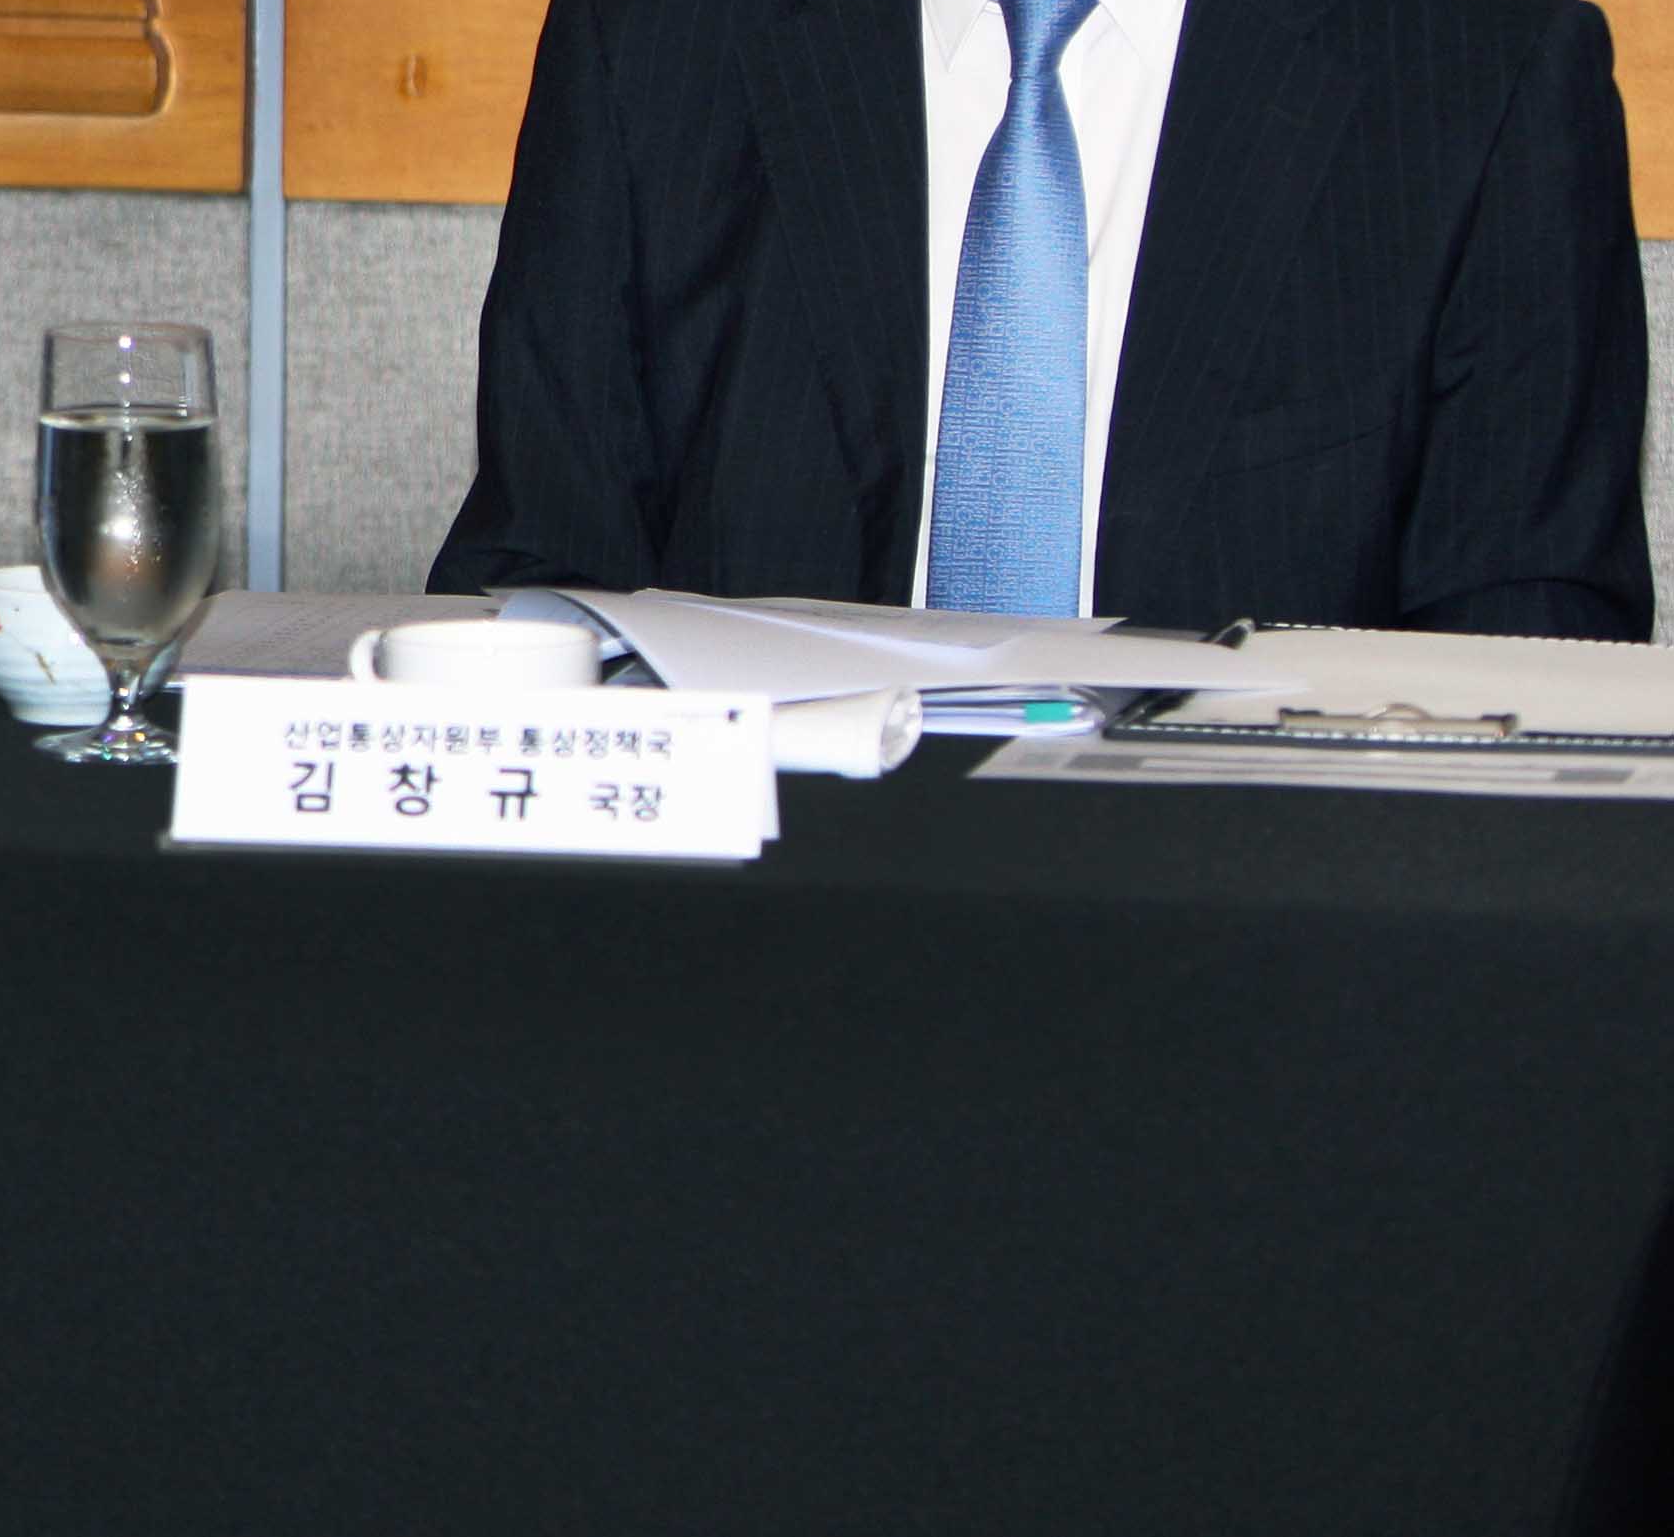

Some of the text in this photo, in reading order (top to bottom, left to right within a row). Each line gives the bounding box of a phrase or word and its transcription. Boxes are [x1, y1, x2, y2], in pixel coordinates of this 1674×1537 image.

[285, 721, 673, 760] 산업통상자원부 통상정책국
[289, 761, 663, 822] 김 창 규 국장
